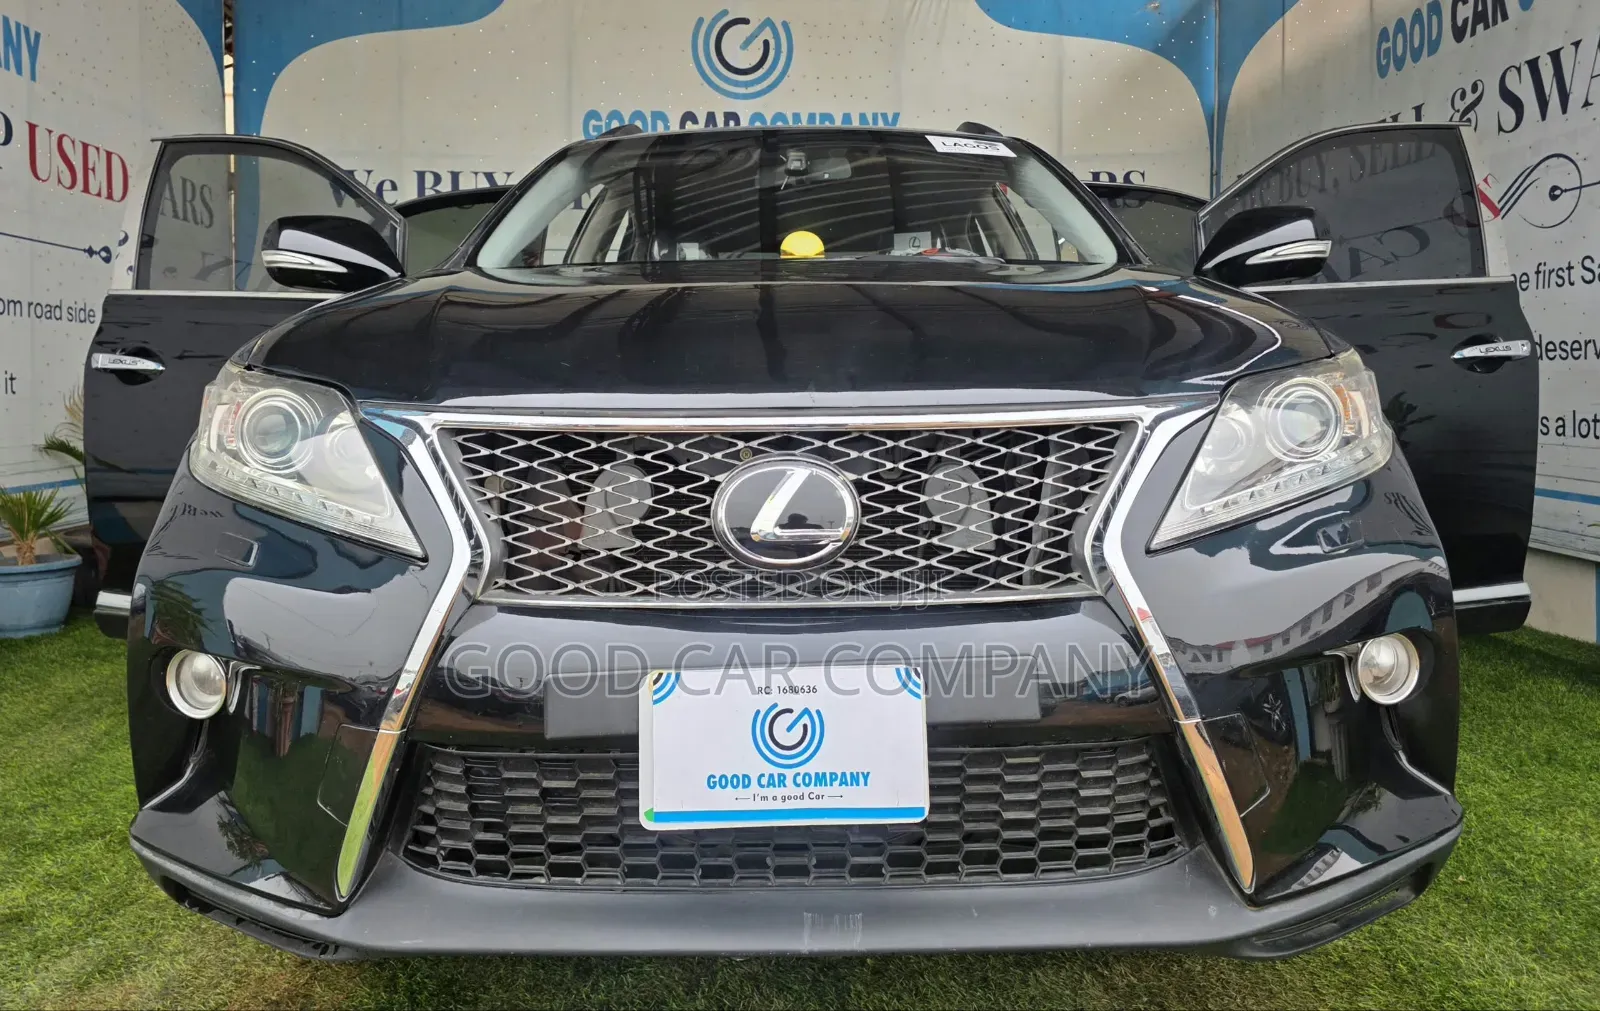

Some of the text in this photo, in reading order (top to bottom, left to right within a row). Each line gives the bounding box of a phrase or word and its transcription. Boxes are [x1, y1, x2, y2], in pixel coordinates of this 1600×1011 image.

[0, 15, 41, 83] NY
[1376, 0, 1443, 80] GOOD
[25, 120, 129, 203] USED
[159, 175, 214, 229] ARS
[1534, 261, 1575, 289] first
[1581, 255, 1600, 285] S
[27, 299, 63, 321] road
[67, 301, 96, 324] side
[1479, 345, 1512, 355] LEXUS
[4, 371, 17, 394] it
[1555, 415, 1566, 437] a
[757, 684, 818, 695] RC: 1680636
[706, 771, 871, 790] GOOD CAR COMPANY
[780, 792, 805, 803] good
[808, 792, 826, 801] Car
